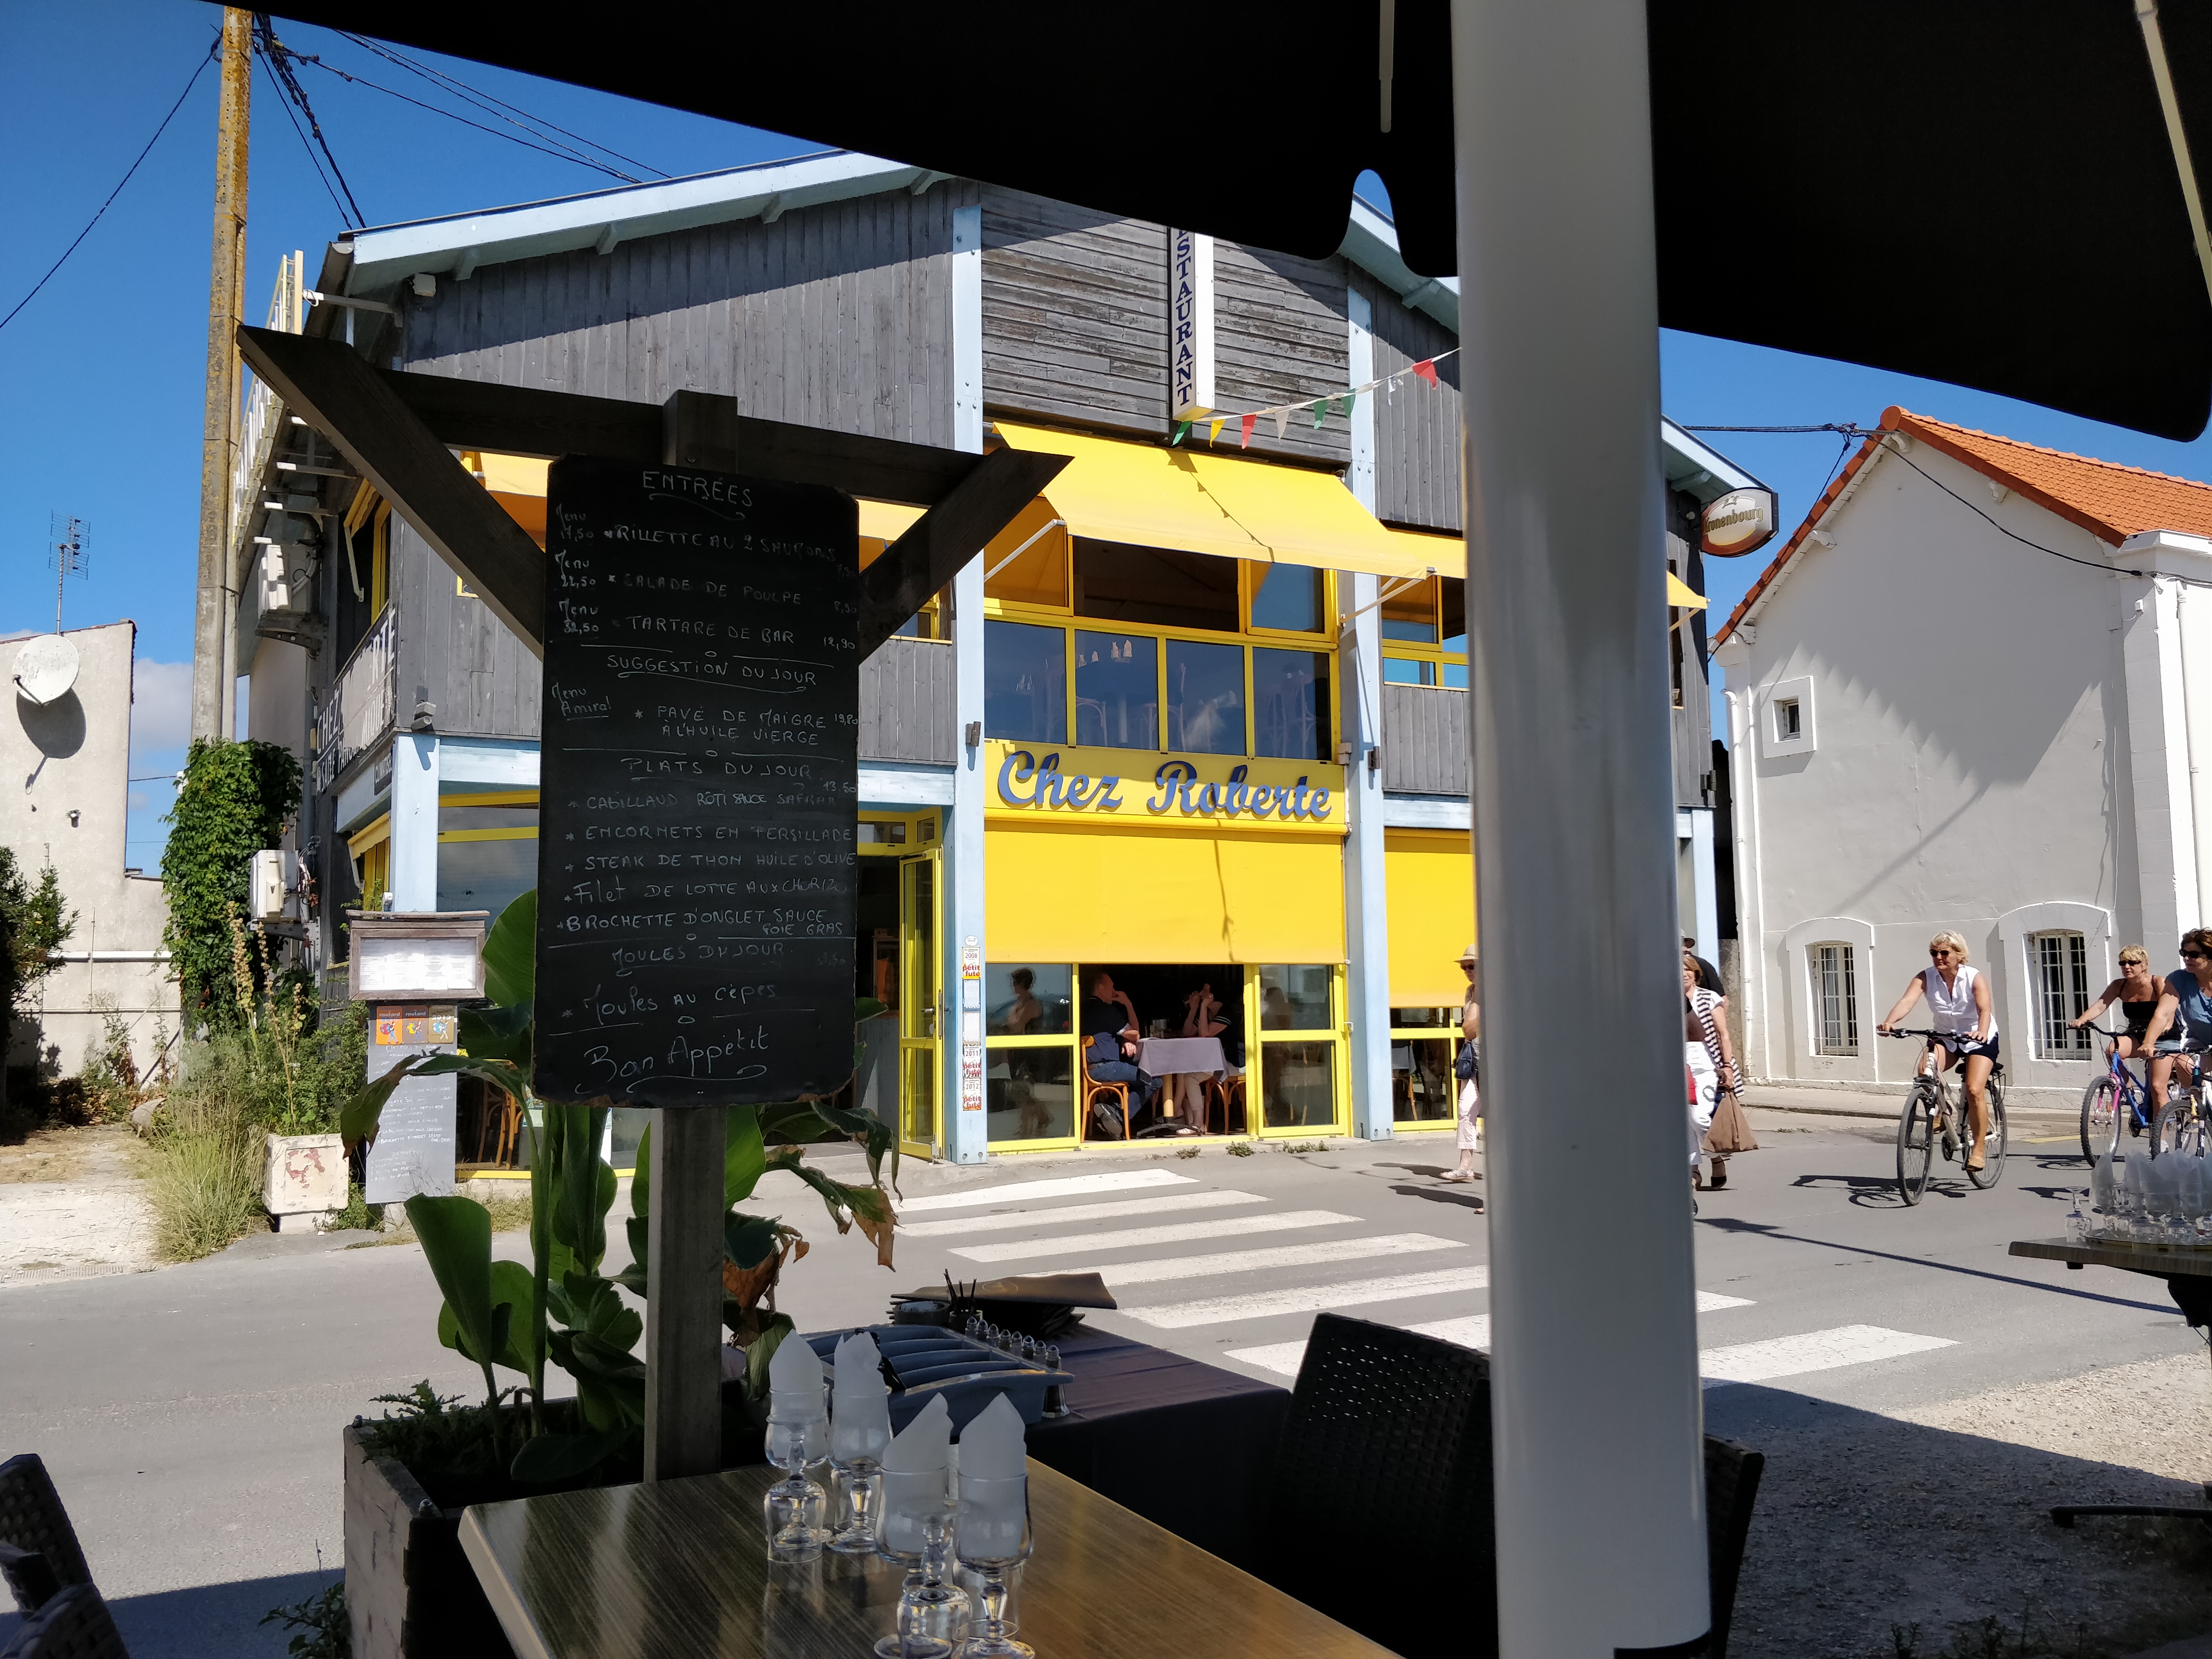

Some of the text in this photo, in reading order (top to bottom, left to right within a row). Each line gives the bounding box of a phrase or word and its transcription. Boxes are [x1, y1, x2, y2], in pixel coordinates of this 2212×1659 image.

[556, 503, 586, 530] Menu
[1704, 507, 1764, 534] Kronenbourg
[615, 524, 702, 546] RILLETTE
[710, 534, 735, 550] AU
[744, 534, 753, 551] 2
[555, 549, 590, 576] Menu
[625, 573, 690, 590] SALADE
[706, 581, 728, 597] DE
[744, 585, 801, 605] POULPE
[558, 598, 599, 620] Menu
[625, 615, 717, 637] TARTARE
[728, 625, 751, 639] DE
[761, 627, 795, 644] BAR
[607, 653, 817, 686] SUGGESTION DU JOUR
[552, 682, 587, 703] Menu
[561, 695, 612, 717] Amiral
[316, 688, 339, 755] CHEZ
[337, 690, 385, 774] PANOMIQUE
[722, 709, 747, 722] DE
[759, 708, 827, 729] MAIGRE
[753, 729, 819, 745] VIERGE
[620, 757, 812, 780] PLATS DU JOUR
[732, 793, 768, 805] SAUCE
[776, 793, 836, 806] SAFRAN
[998, 750, 1333, 822] Chez Roberte
[585, 825, 703, 840] ENCORNETS
[715, 827, 739, 839] EN
[584, 851, 857, 870] STEAK DE THON HUILE D'OLIVE
[572, 874, 848, 904] Filet DE LOTTE AUX CHORIZO
[566, 907, 827, 932] BROCHETTE D'ONGLET SAUCE
[762, 922, 843, 936] FOIE GRAS
[612, 942, 784, 969] MOULES DU JOUR
[583, 984, 659, 1025] Moules
[673, 993, 697, 1006] AU
[577, 1045, 655, 1087] Bon
